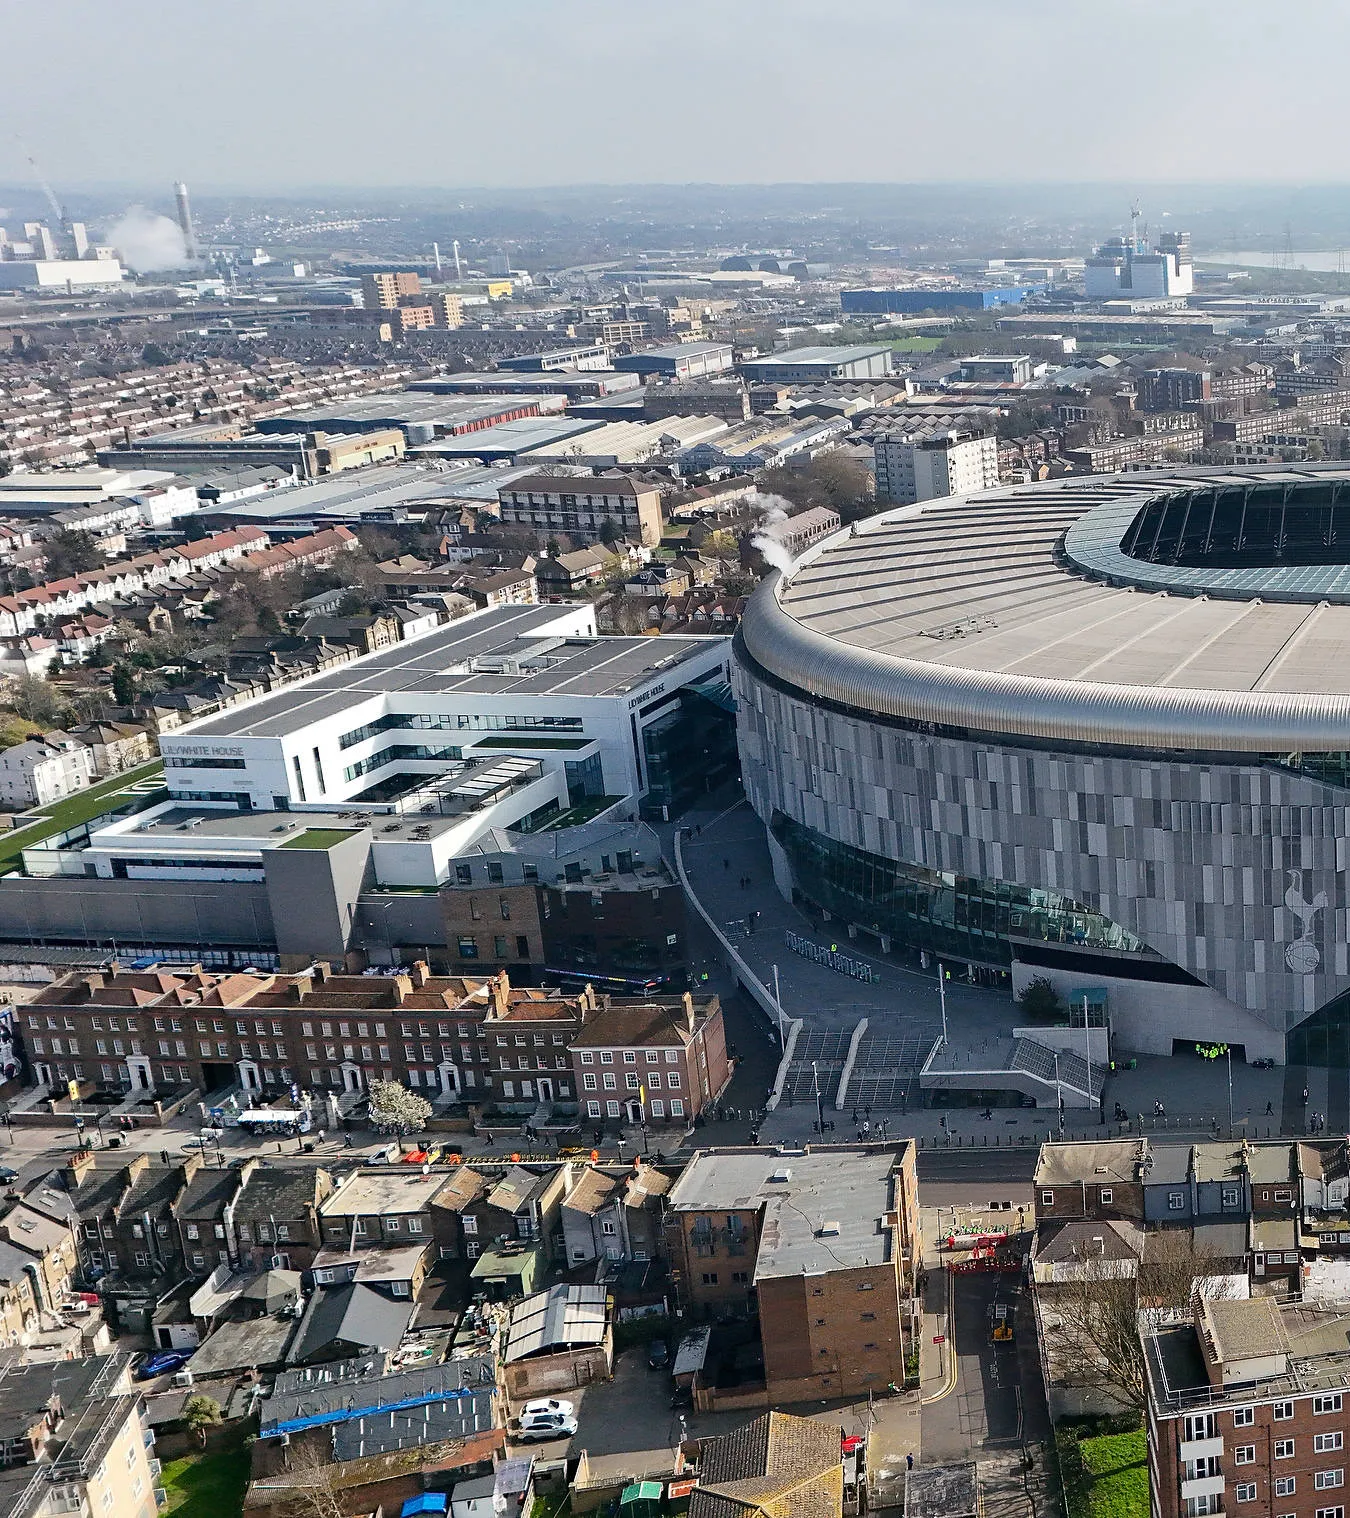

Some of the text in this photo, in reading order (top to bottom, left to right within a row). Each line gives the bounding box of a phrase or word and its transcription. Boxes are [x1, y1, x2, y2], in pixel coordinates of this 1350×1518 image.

[628, 682, 665, 710] LILYWHITE HOUSE
[162, 745, 244, 756] LILYWHITE HOUSE
